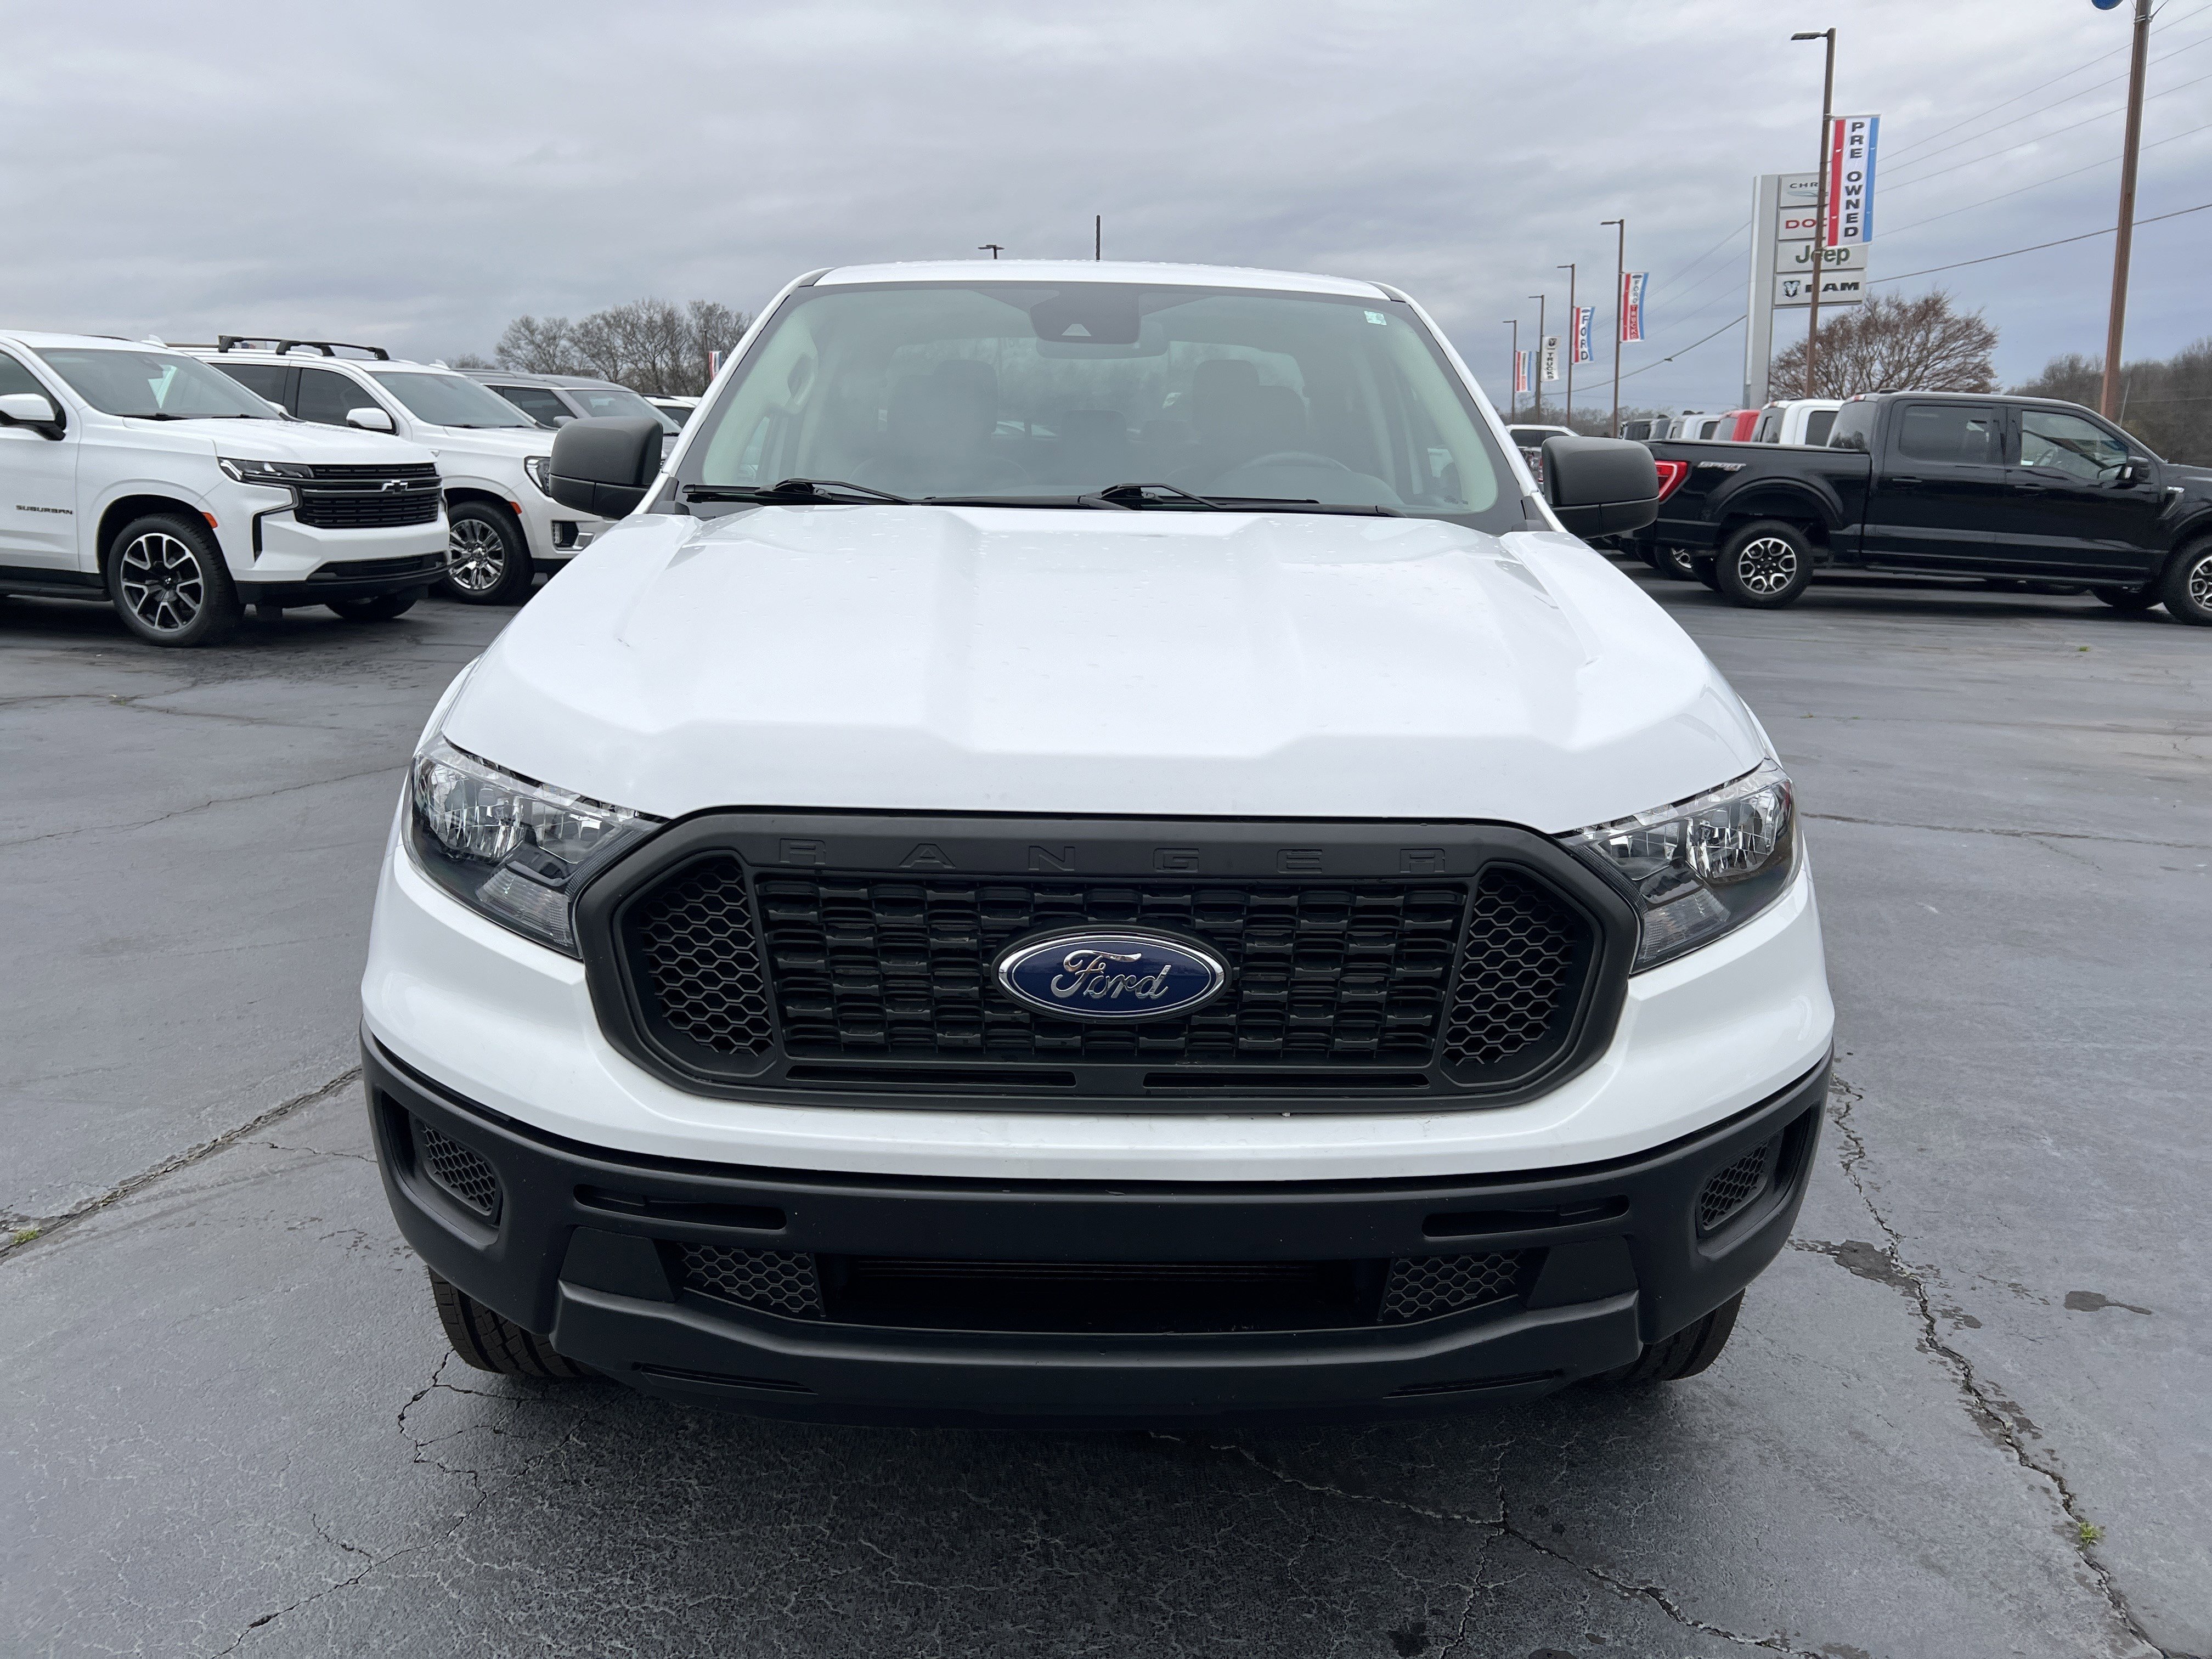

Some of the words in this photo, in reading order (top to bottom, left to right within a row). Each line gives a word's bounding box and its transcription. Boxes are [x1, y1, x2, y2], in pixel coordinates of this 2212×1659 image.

[1850, 122, 1865, 159] PRE
[1844, 171, 1863, 237] OWNED
[1581, 315, 1589, 360] FORD
[15, 505, 72, 515] SUBURBAN
[779, 838, 1446, 874] RANGER
[1050, 949, 1171, 1000] Ford
